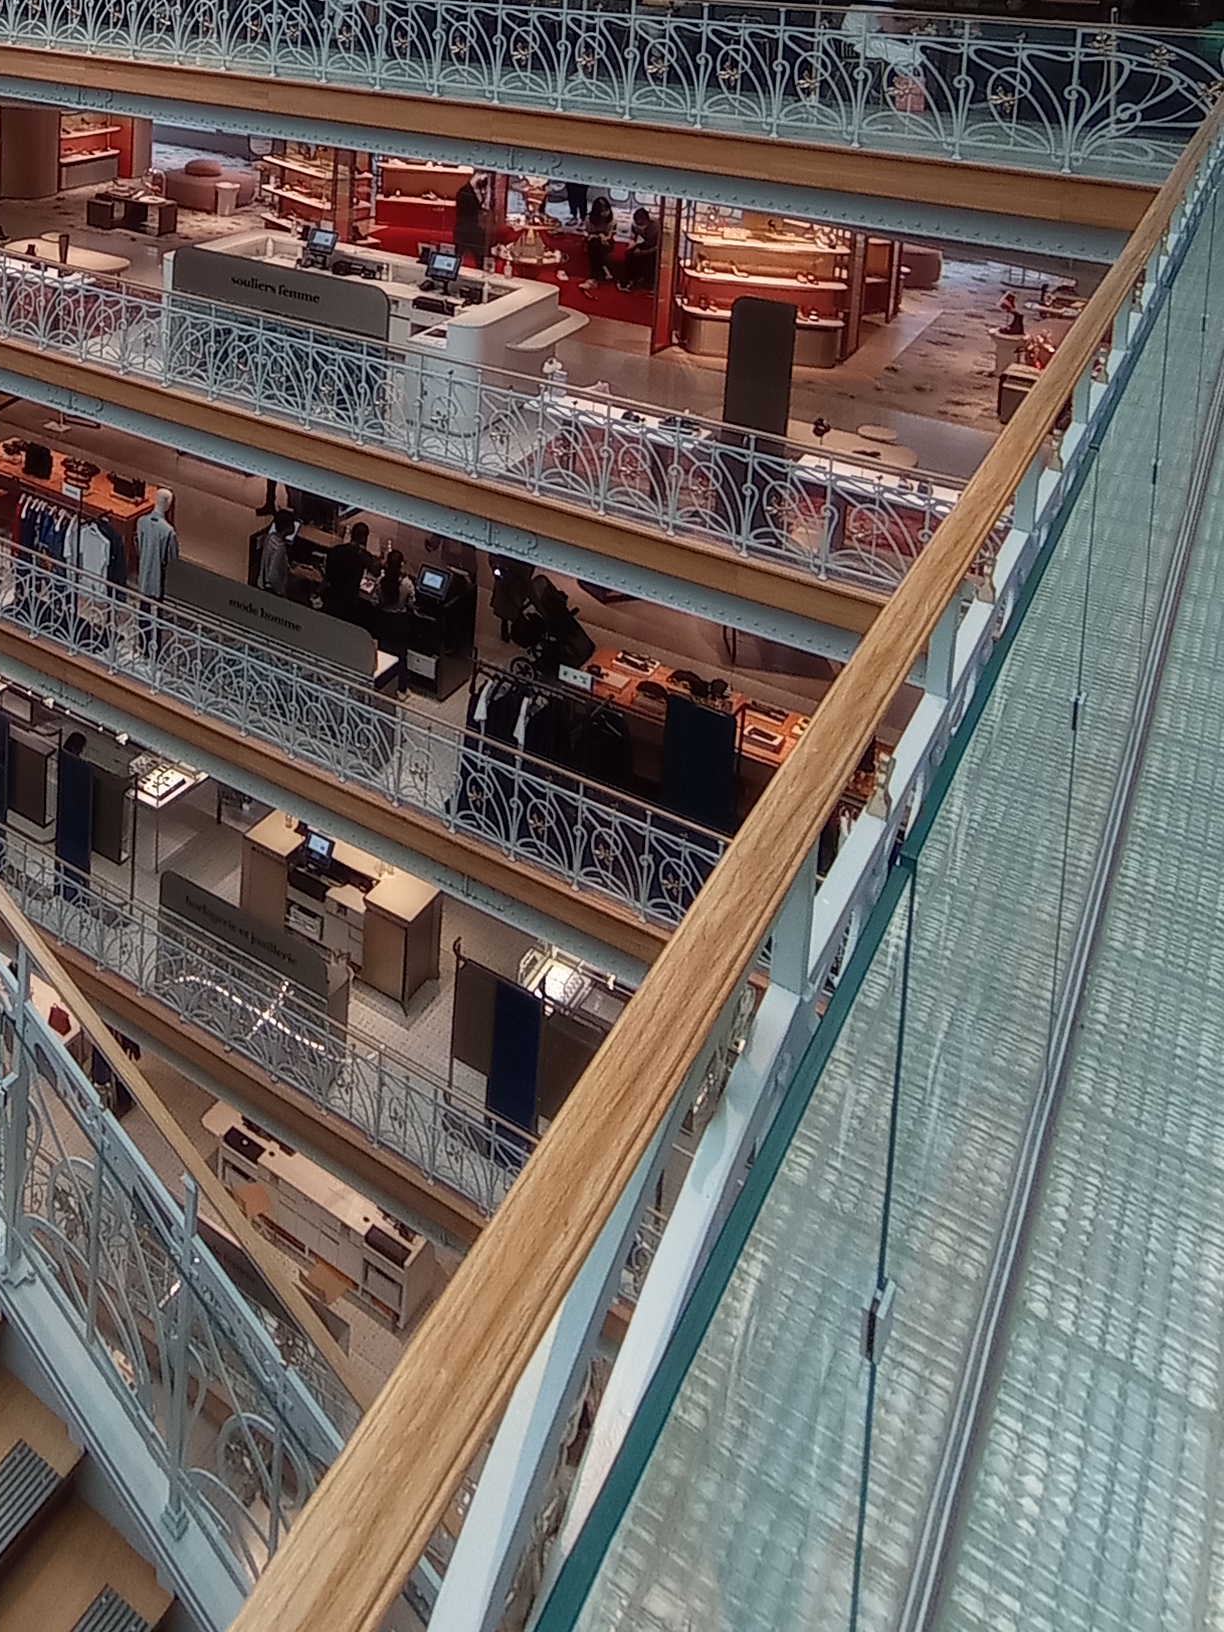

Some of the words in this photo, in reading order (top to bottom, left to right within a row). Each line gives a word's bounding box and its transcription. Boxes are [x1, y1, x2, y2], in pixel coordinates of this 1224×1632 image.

[230, 277, 277, 294] souliers
[278, 284, 321, 304] femme
[228, 599, 259, 616] mode
[260, 607, 302, 633] homme
